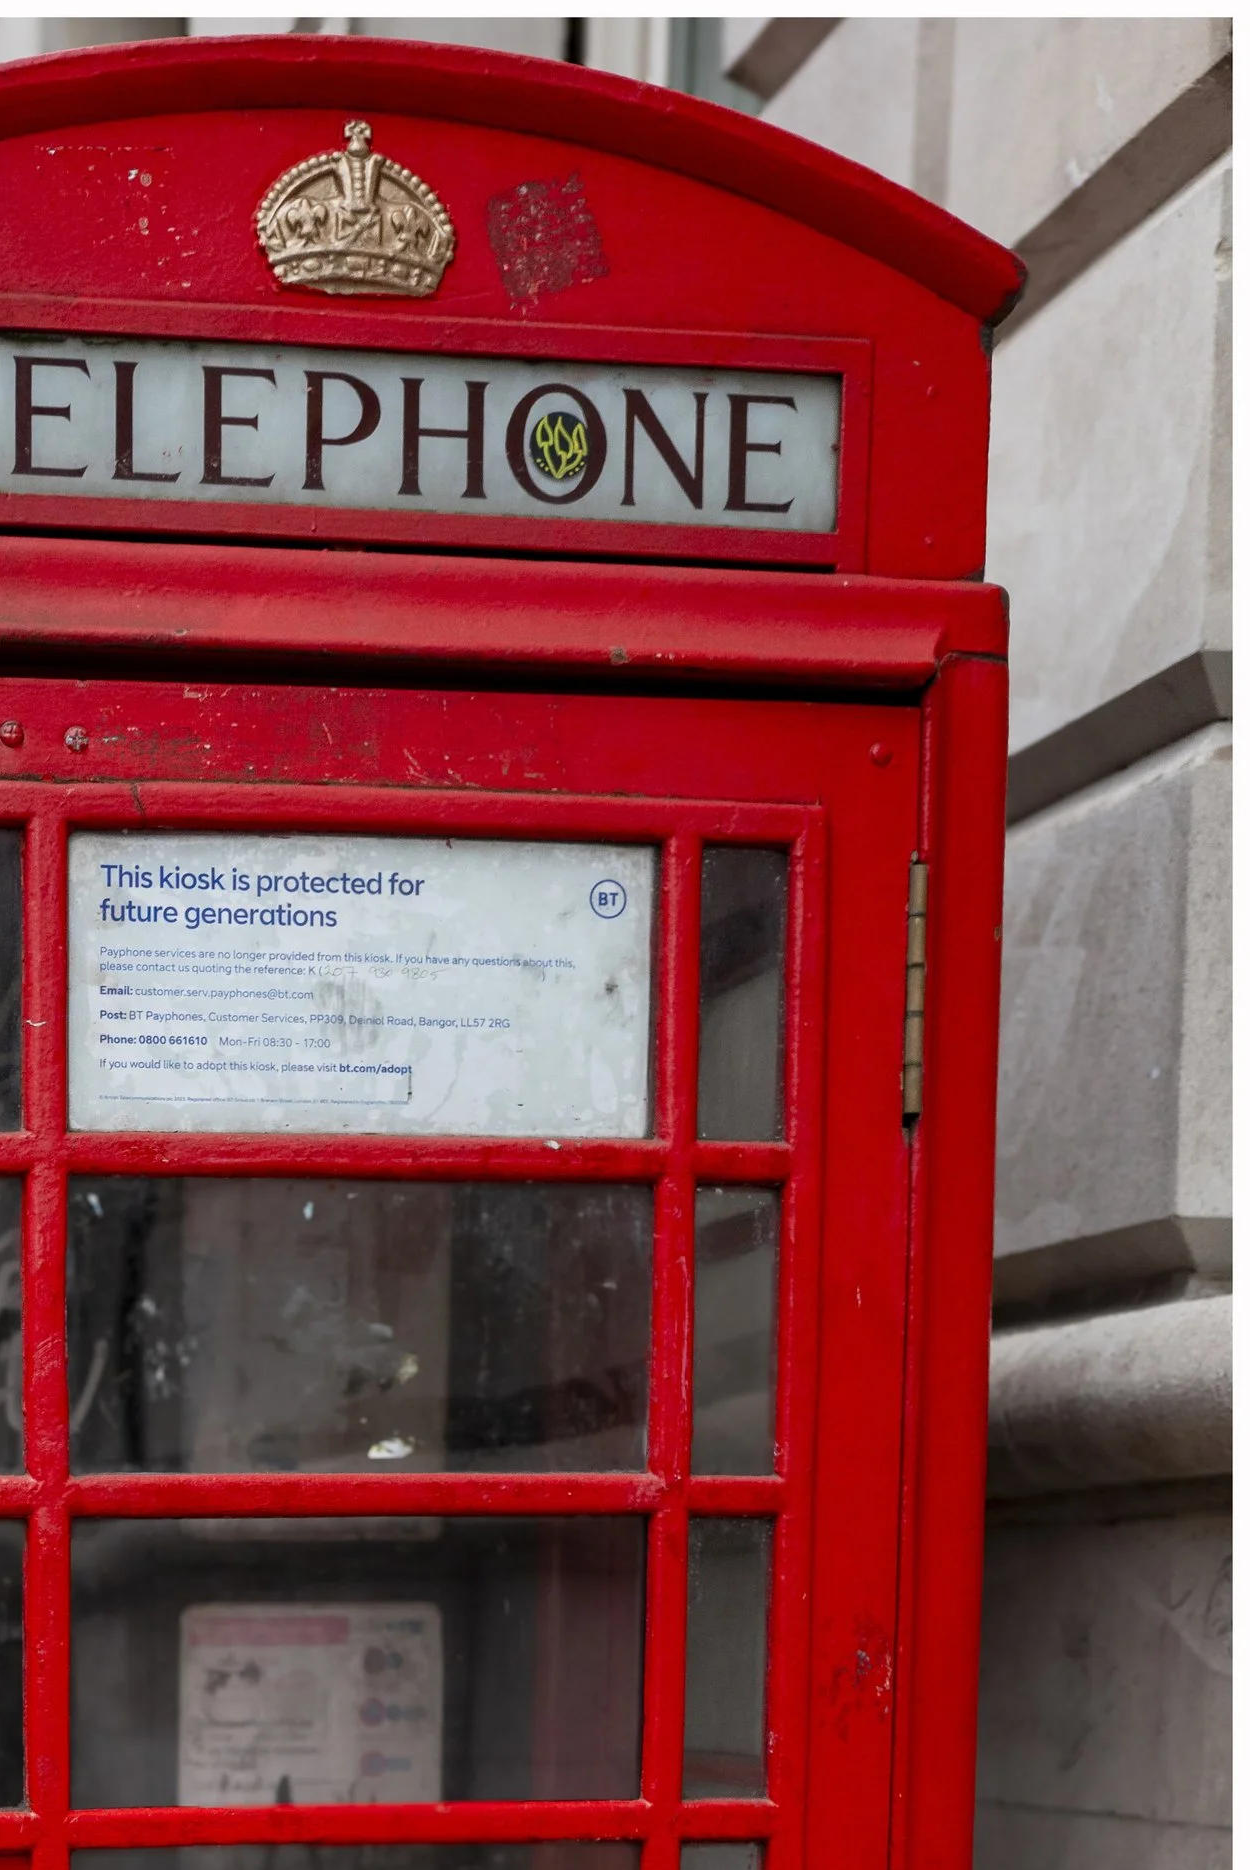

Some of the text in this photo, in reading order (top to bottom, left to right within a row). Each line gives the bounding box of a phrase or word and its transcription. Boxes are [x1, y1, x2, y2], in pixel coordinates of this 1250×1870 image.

[100, 864, 425, 897] This kiosk is protected for
[598, 891, 619, 907] BT
[99, 898, 338, 930] future generations
[99, 946, 576, 970] Payphone services are no longer provided from this kiosk. If you have any questions about this,
[99, 961, 133, 973] please
[136, 963, 176, 972] contact
[191, 964, 232, 976] quoting
[234, 964, 251, 974] the
[253, 964, 306, 975] reference:
[99, 985, 314, 1000] Email: customer.serv.payphones@bt.com
[99, 1010, 127, 1020] Post:
[129, 1010, 143, 1020] BT
[145, 1011, 206, 1023] Payphones,
[208, 1012, 258, 1023] Customer
[261, 1013, 307, 1025] Services,
[386, 1016, 417, 1027] Road,
[418, 1017, 458, 1029] Bangor,
[460, 1018, 485, 1028] LL57
[488, 1018, 510, 1029] 2RG
[99, 1034, 137, 1045] Phone:
[138, 1035, 166, 1045] 0800
[169, 1035, 208, 1046] 661610
[219, 1036, 261, 1047] Mon-Fri
[262, 1037, 293, 1048] 08:30
[303, 1038, 331, 1048] 17:00
[99, 1058, 412, 1075] If you would like to adopt this kiosk, please visit bt.com/adopt
